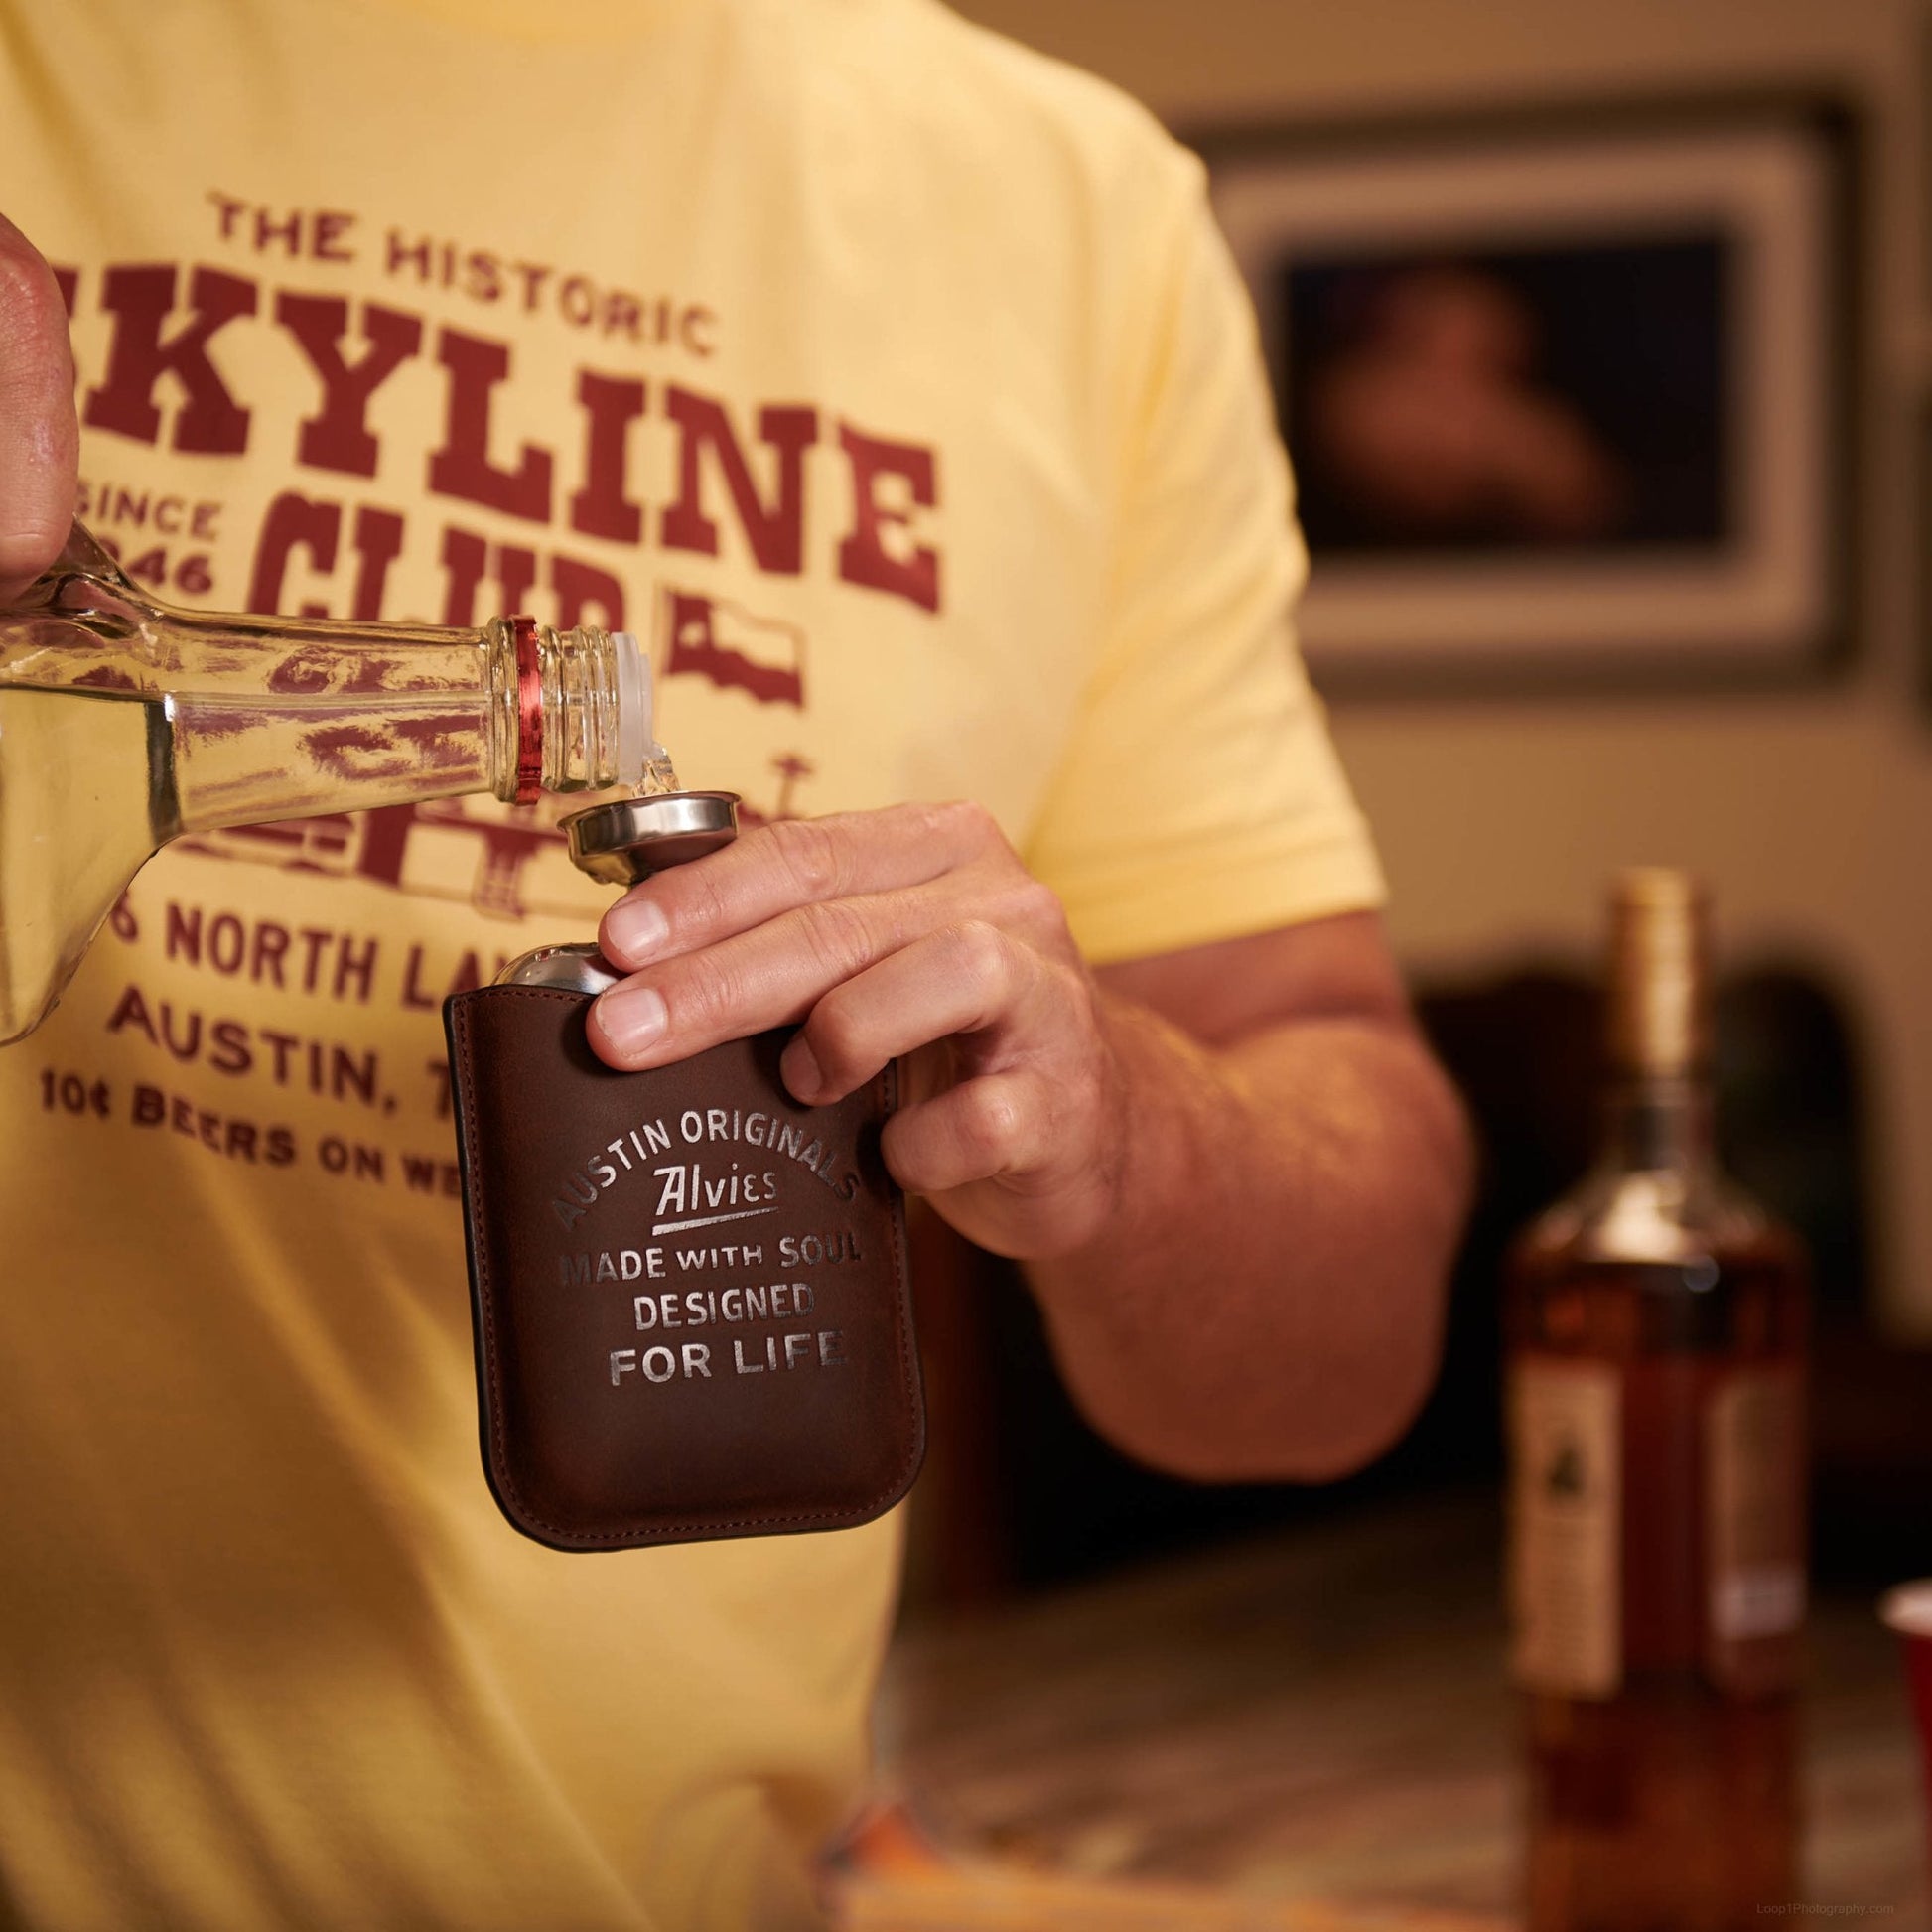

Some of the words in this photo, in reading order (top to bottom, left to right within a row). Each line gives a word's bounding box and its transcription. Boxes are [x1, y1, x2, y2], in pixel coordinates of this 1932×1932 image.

[205, 192, 359, 263] THE
[386, 228, 719, 359] HISTORIC
[50, 260, 942, 614] KYLINE
[164, 901, 380, 1008] NORTH
[105, 983, 397, 1118] AUSTIN,
[130, 1082, 297, 1169] BEERS
[315, 1133, 386, 1186] ON
[551, 1118, 672, 1233] AUSTIN
[680, 1108, 862, 1205] ORIGINALS
[651, 1162, 778, 1217] Alvies
[559, 1246, 666, 1288] MADE
[675, 1243, 763, 1272] WITH
[778, 1231, 863, 1269] SOUL
[632, 1281, 816, 1332] DESIGNED
[609, 1341, 712, 1387] FOR
[733, 1330, 847, 1375] LIFE
